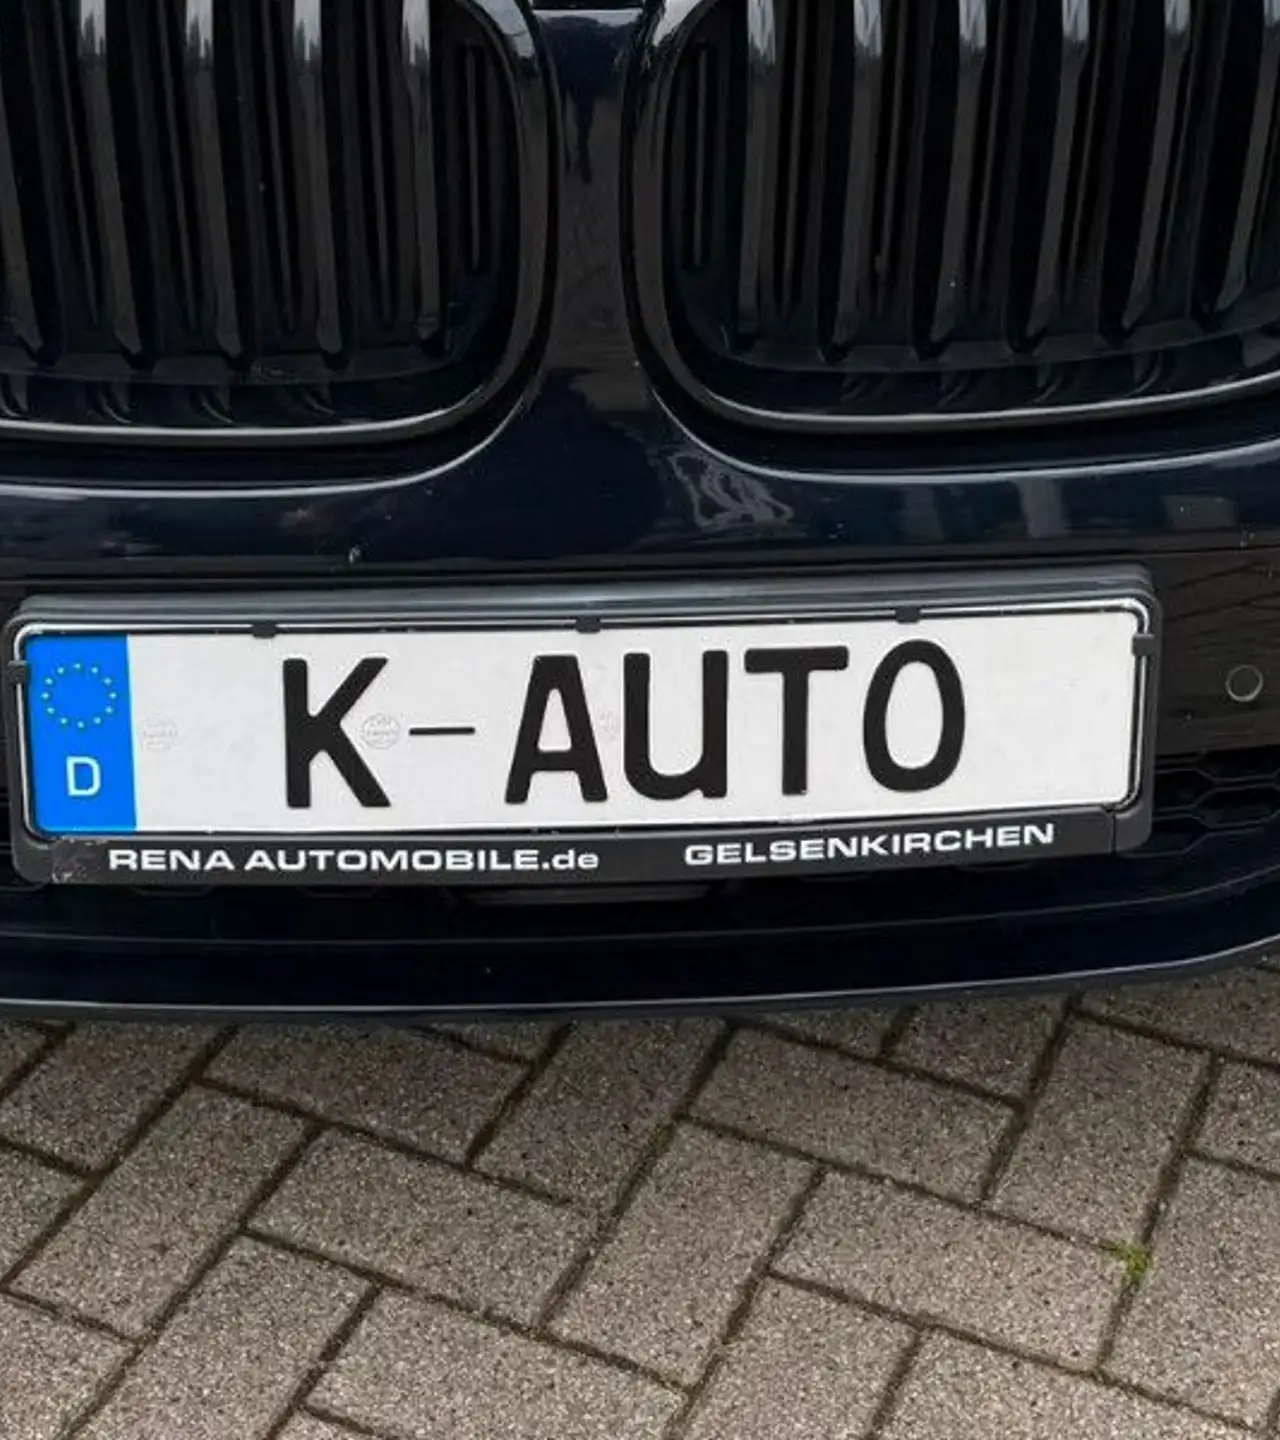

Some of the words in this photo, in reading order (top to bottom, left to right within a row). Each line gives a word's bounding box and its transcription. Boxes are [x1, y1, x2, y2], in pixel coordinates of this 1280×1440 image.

[66, 755, 102, 798] D
[108, 849, 235, 872] RENA
[244, 848, 599, 873] AUTOMOBILE.de
[684, 822, 1055, 867] GELSENKIRCHEN
